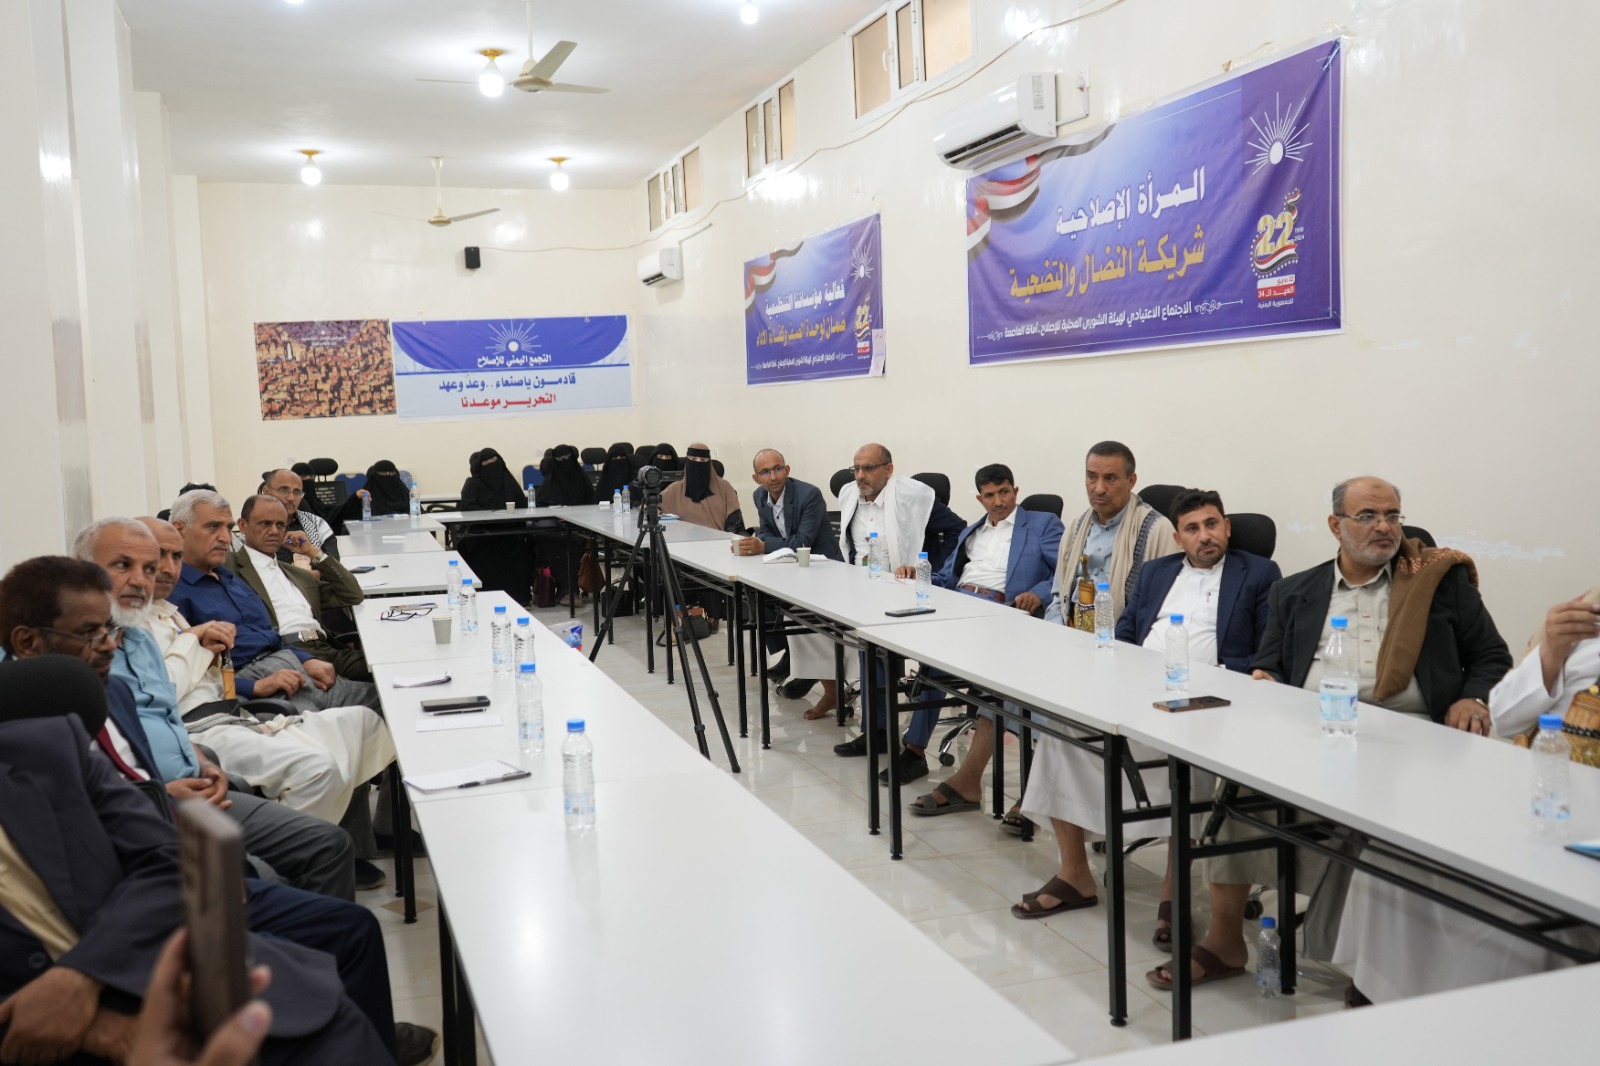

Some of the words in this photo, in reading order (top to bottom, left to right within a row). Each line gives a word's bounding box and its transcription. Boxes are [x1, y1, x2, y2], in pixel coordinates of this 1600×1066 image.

[1137, 165, 1205, 219] المرأة
[1056, 186, 1131, 240] الإصلاحية
[1257, 211, 1295, 257] 22
[1137, 223, 1206, 281] شريكة
[1079, 243, 1133, 295] النضال
[1009, 257, 1076, 304] والتضحية
[794, 287, 822, 310] مؤسساتنا
[824, 278, 845, 306] فعالية
[1273, 286, 1294, 297] العيد
[1061, 316, 1082, 333] المحلية
[1108, 310, 1126, 327] لهيئة
[1127, 305, 1160, 327] الاعتيادي
[477, 355, 504, 368] للإصلاح
[506, 355, 528, 368] اليمني
[529, 354, 552, 366] التجمع
[439, 380, 463, 392] وعهد
[533, 372, 576, 389] قادمون
[461, 397, 500, 409] موعدنا
[503, 393, 556, 409] التحرير
